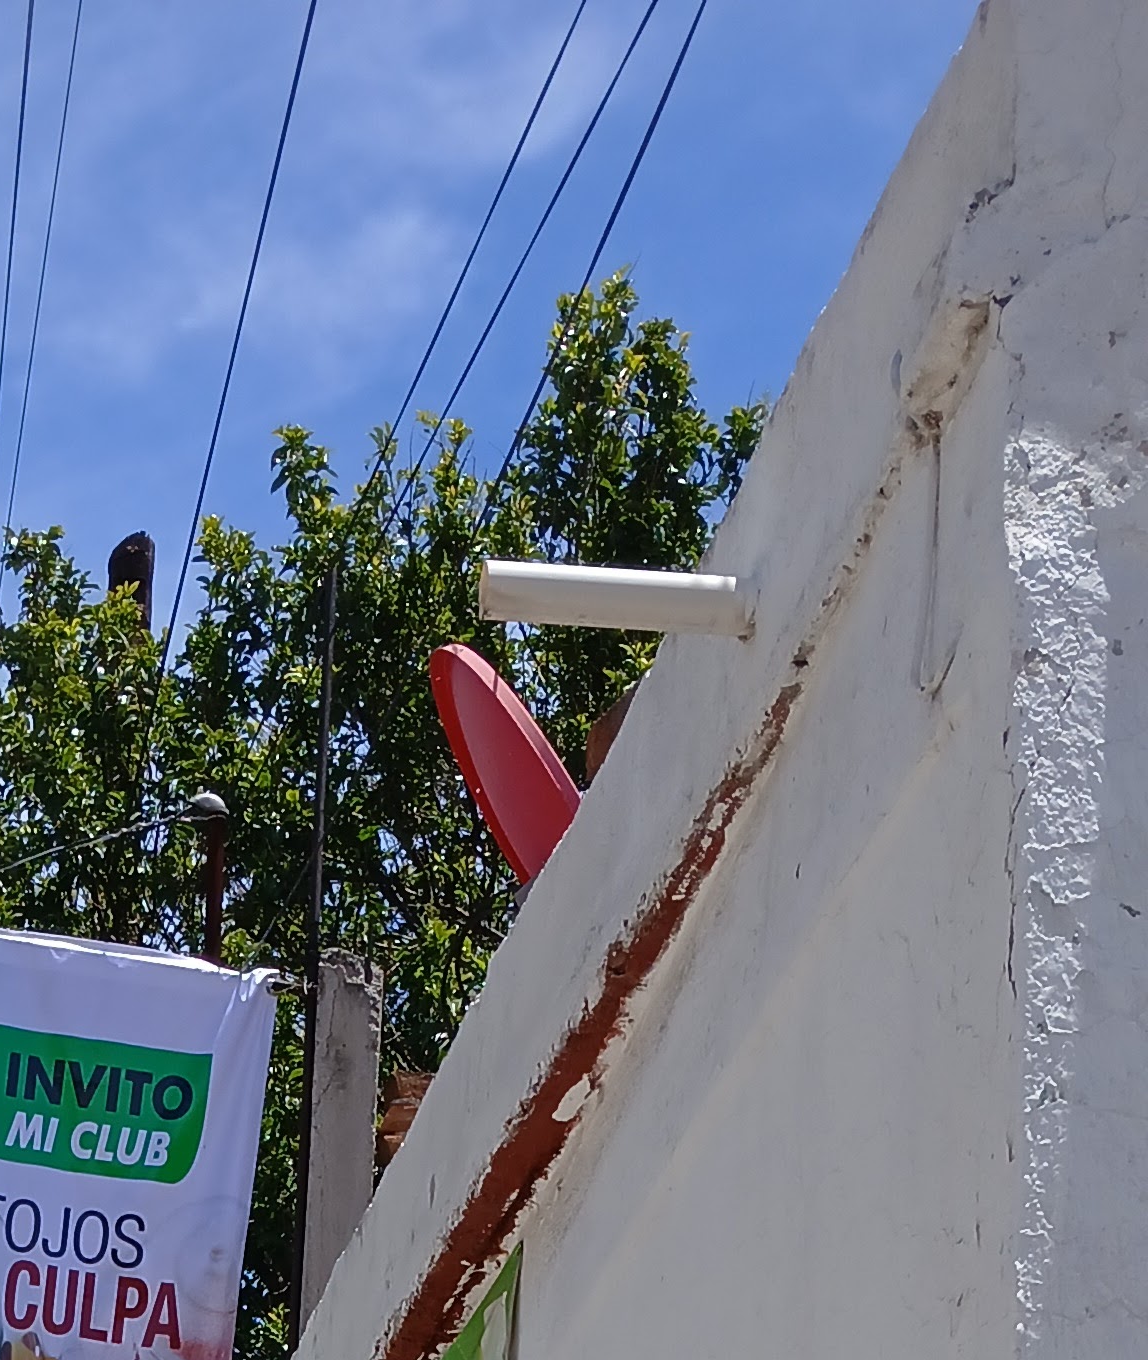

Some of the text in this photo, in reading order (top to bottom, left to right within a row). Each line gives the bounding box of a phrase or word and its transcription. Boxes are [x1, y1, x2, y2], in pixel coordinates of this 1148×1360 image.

[5, 1052, 193, 1121] INVITO
[5, 1115, 59, 1155] MI
[69, 1120, 170, 1168] CLUB
[4, 1260, 182, 1350] CULPA
